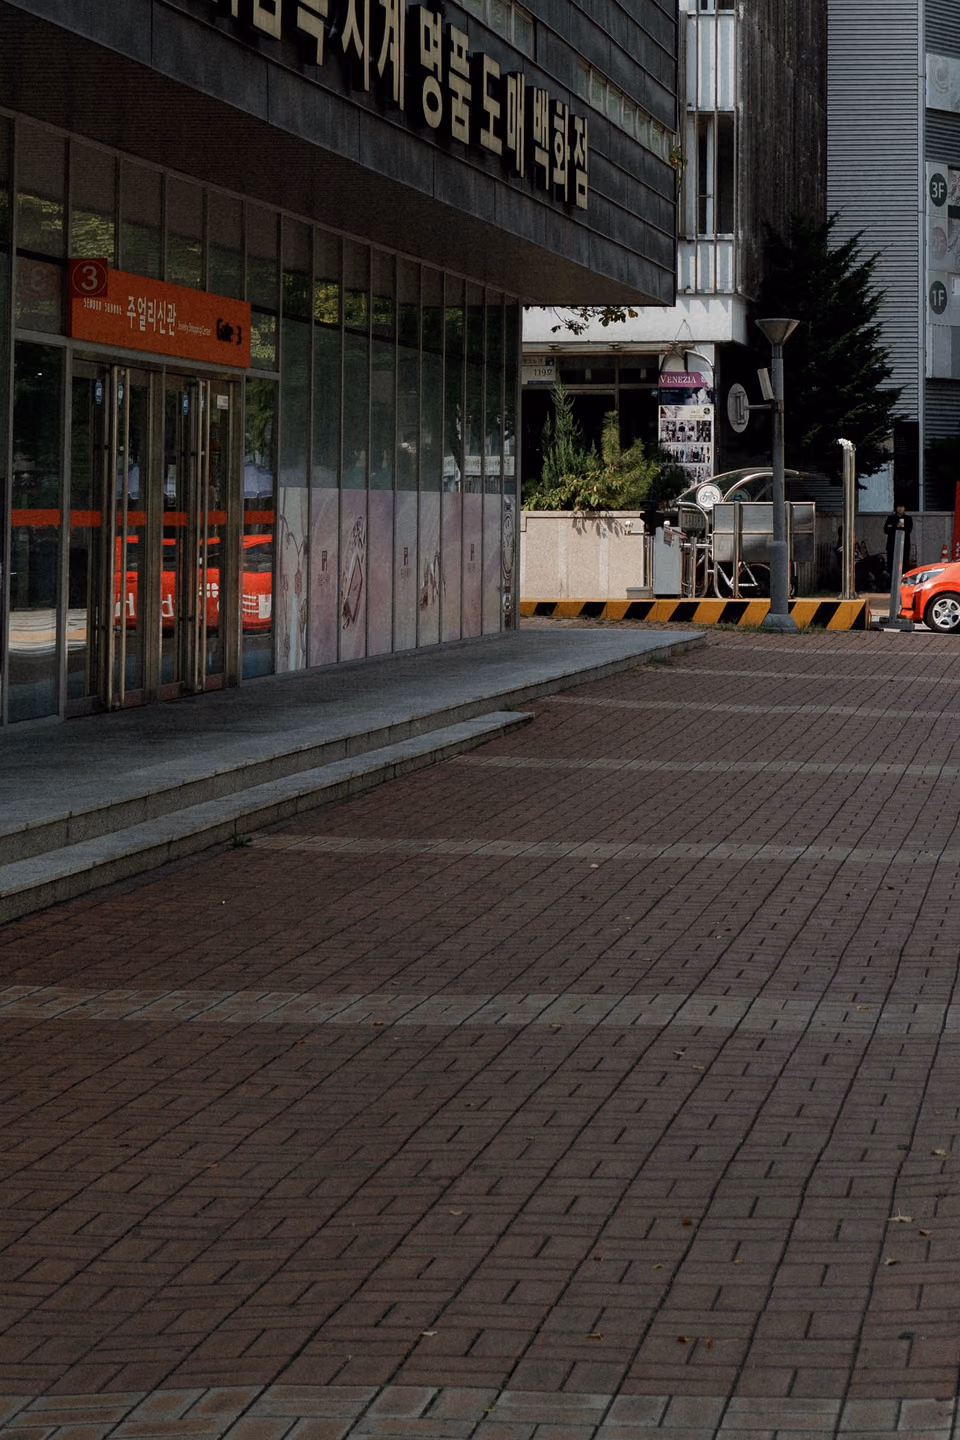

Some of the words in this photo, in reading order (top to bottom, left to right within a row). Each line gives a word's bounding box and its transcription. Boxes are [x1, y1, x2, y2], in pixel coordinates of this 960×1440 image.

[533, 88, 588, 211] 백화점
[932, 182, 945, 198] 3F
[81, 265, 98, 291] 3
[932, 289, 945, 307] 1F
[126, 295, 177, 337] 주얼리신관
[236, 325, 242, 346] 3
[659, 373, 697, 384] VENEZIA
